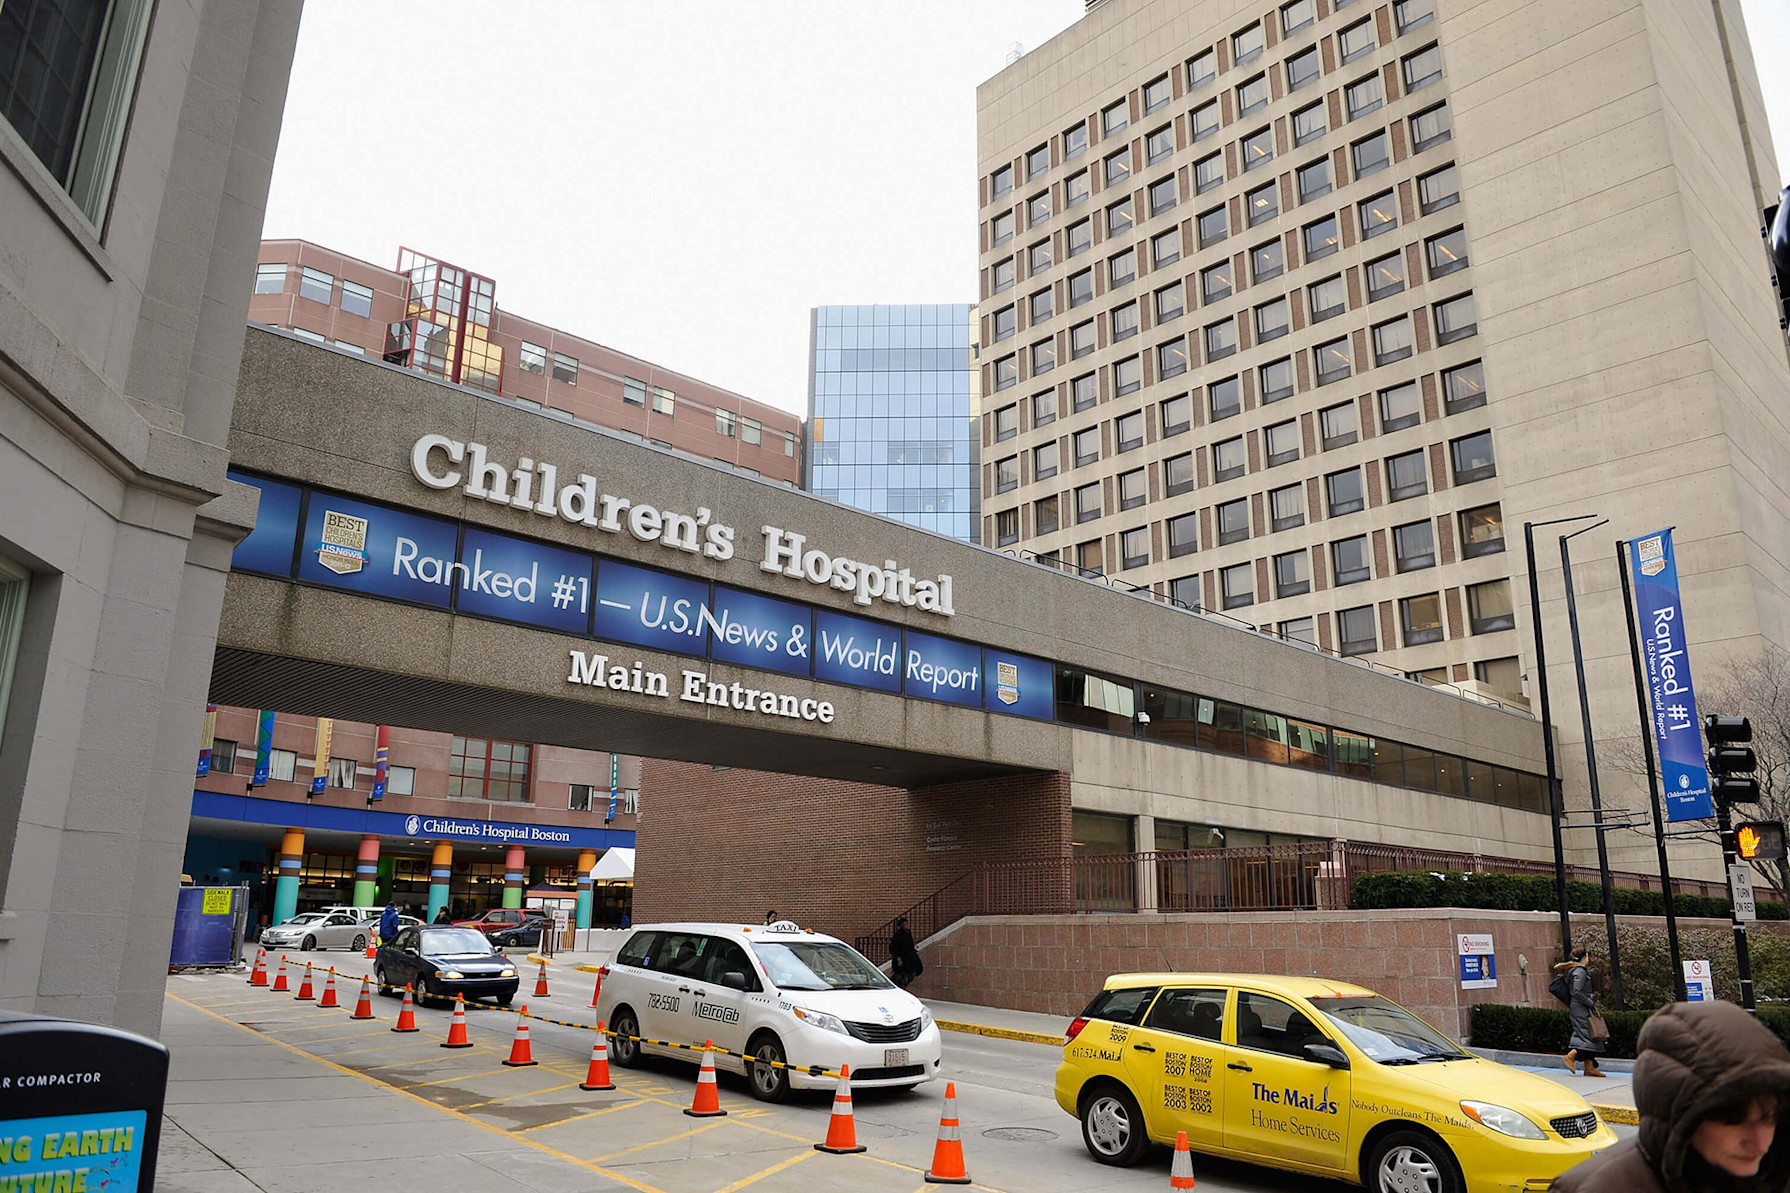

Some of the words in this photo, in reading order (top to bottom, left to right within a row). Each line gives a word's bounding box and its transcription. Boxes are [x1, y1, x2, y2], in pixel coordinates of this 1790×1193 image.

[328, 513, 364, 532] BEST
[410, 434, 735, 561] Children's
[760, 525, 955, 616] Hospital
[324, 533, 362, 549] HOSPITALS
[1640, 538, 1660, 550] BEST
[392, 537, 538, 602] Ranked
[552, 575, 588, 613] #1
[785, 624, 808, 658] &
[822, 630, 897, 675] World
[906, 649, 979, 693] Report
[1653, 606, 1688, 695] Ranked
[1652, 676, 1660, 684] &
[567, 651, 669, 697] Main
[680, 670, 835, 723] Entrance
[1654, 685, 1664, 710] World
[1667, 704, 1691, 730] #1
[1656, 712, 1667, 740] Report
[423, 820, 480, 836] Children's
[482, 824, 529, 841] Hospital
[531, 829, 570, 842] Boston
[1736, 873, 1745, 884] NO
[1736, 887, 1750, 898] TURN
[1736, 902, 1743, 913] ON
[1744, 902, 1754, 913] RED
[774, 924, 797, 932] TAXI
[1109, 1033, 1127, 1042] 2009
[1166, 1051, 1178, 1059] BEST
[1165, 1058, 1187, 1066] BOSTON
[1190, 1062, 1213, 1070] BOSTON
[1165, 1065, 1186, 1076] 2007
[1190, 1067, 1211, 1078] HOME
[17, 1072, 102, 1087] COMPACTOR
[1164, 1084, 1178, 1092] BEST
[1189, 1087, 1203, 1096] BEST
[1252, 1082, 1280, 1104] The
[1164, 1092, 1187, 1100] BOSTON
[1189, 1095, 1212, 1103] BOSTON
[1164, 1097, 1187, 1109] 2003
[1190, 1101, 1213, 1113] 2002
[1351, 1099, 1379, 1114] Nobody
[1381, 1104, 1422, 1119] Outcleans
[1424, 1111, 1441, 1123] The
[1251, 1108, 1287, 1132] Home
[1289, 1116, 1341, 1143] Services
[42, 1127, 134, 1160] EARTH
